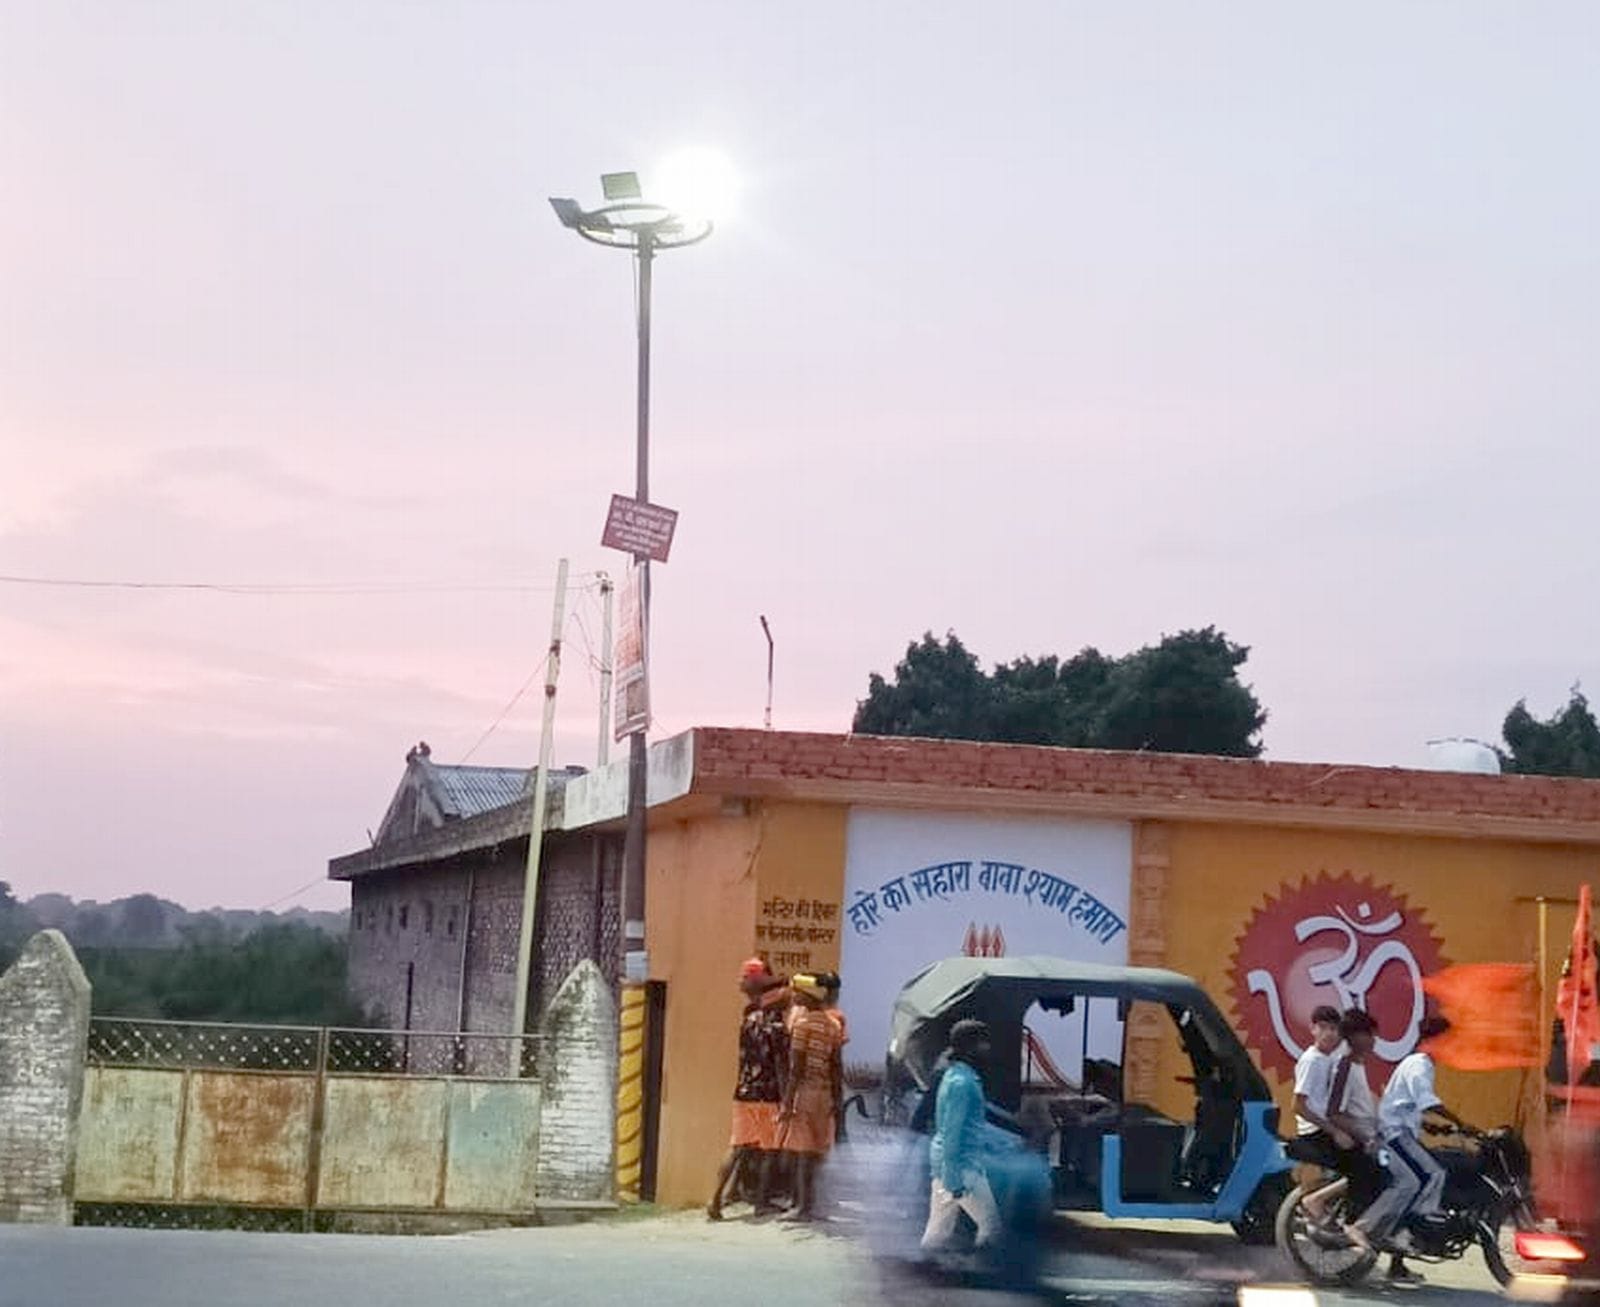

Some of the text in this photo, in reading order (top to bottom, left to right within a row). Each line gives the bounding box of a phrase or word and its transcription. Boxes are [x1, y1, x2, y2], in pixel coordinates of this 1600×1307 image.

[880, 877, 911, 911] का
[908, 861, 973, 902] सहारा
[1024, 869, 1080, 913] श्याम
[1068, 890, 1127, 945] हमारा
